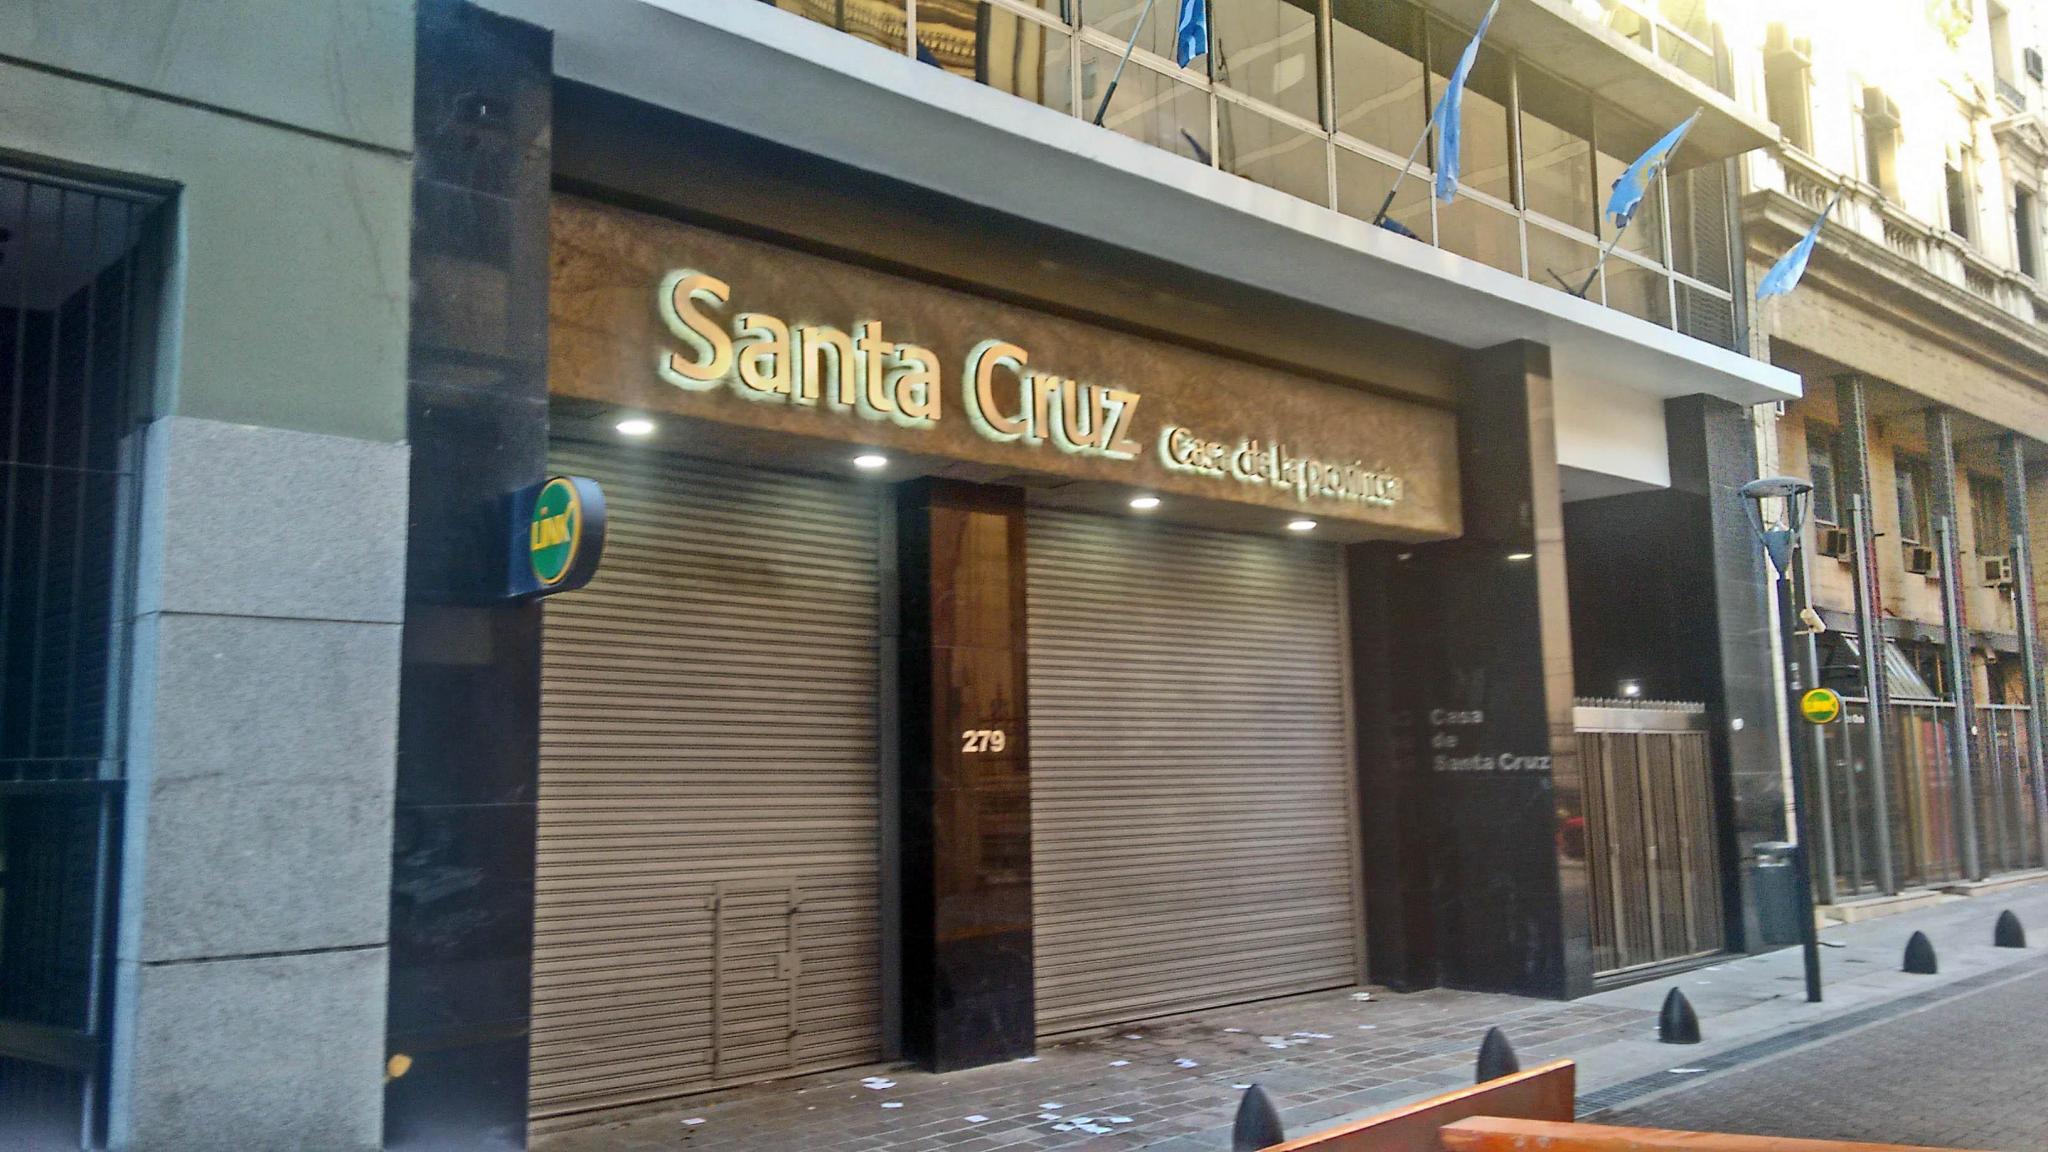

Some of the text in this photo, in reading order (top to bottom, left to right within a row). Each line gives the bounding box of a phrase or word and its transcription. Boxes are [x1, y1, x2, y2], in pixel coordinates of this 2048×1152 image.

[663, 271, 1143, 459] Santa Cruz
[1163, 426, 1232, 475] Casa
[1430, 709, 1484, 725] Casa
[961, 729, 1006, 753] 279
[1431, 732, 1458, 748] de
[1433, 752, 1551, 771] Santa Cruz
